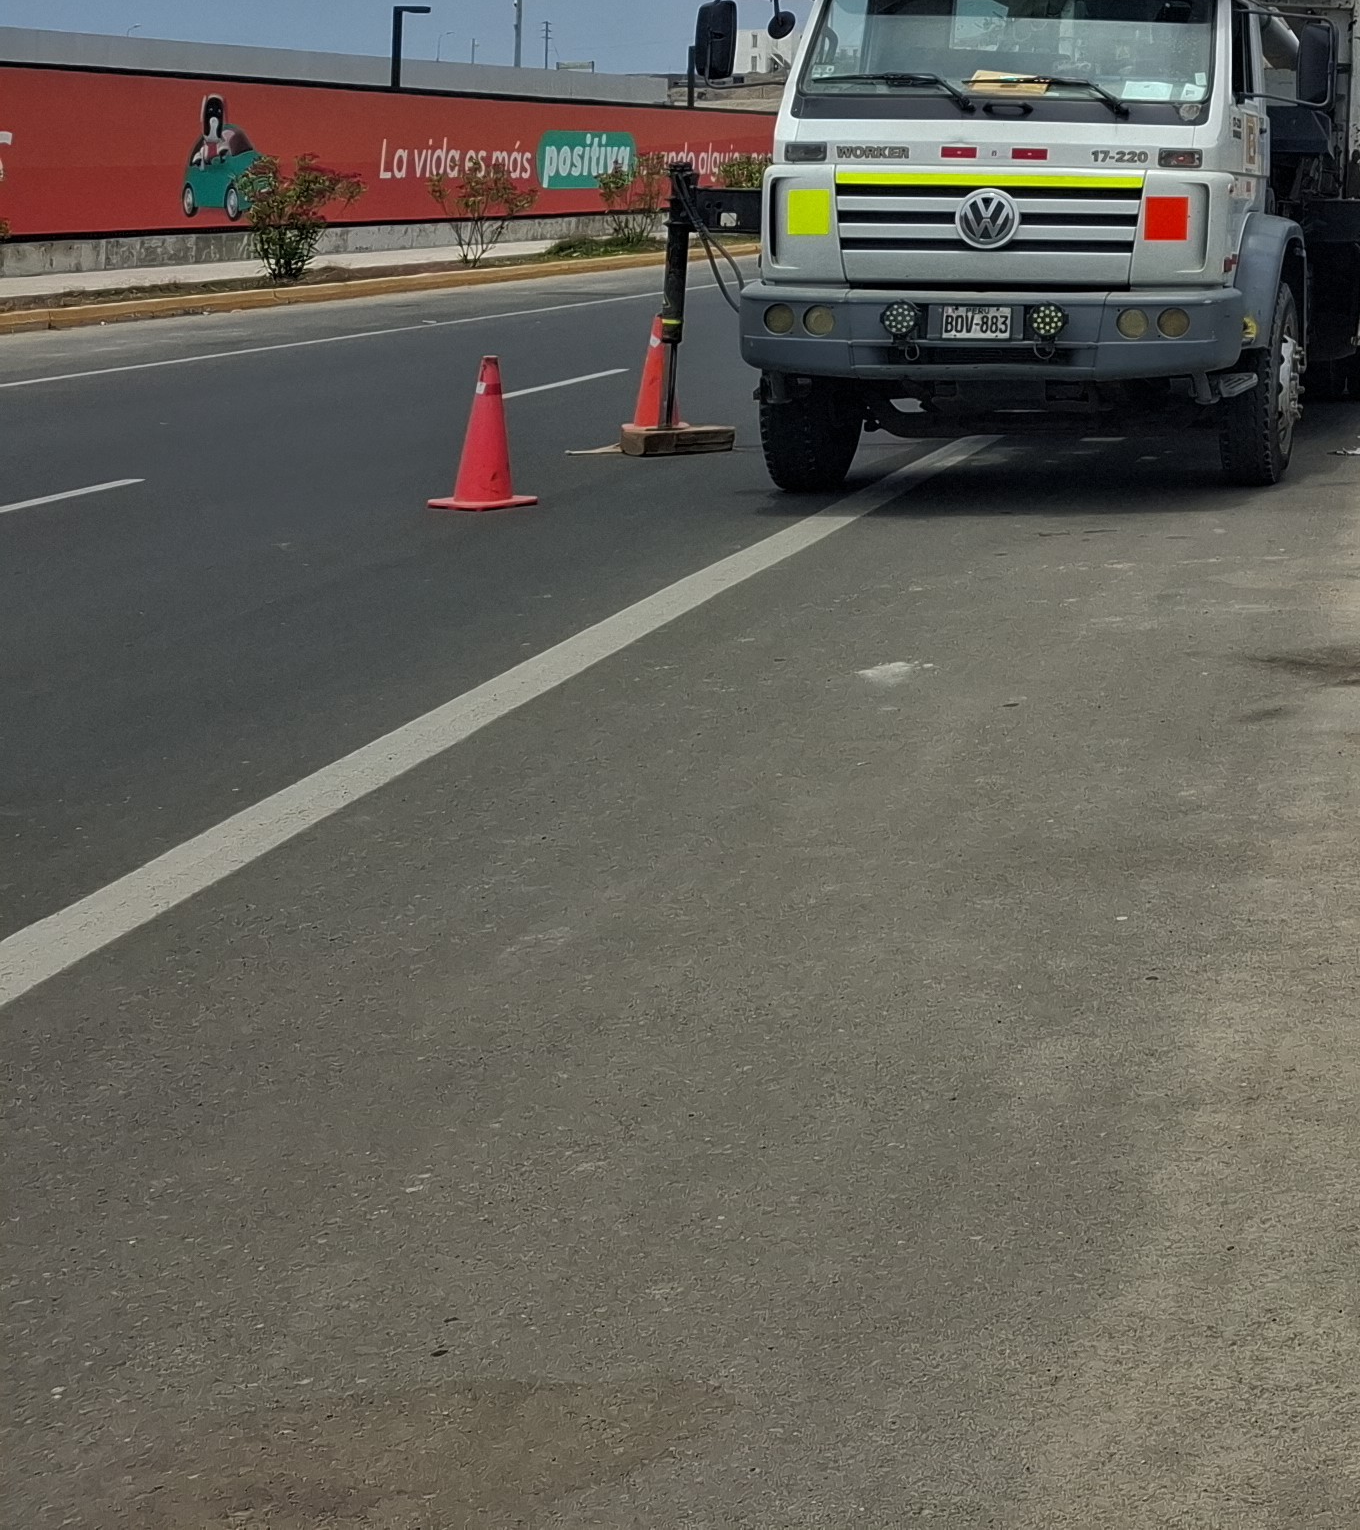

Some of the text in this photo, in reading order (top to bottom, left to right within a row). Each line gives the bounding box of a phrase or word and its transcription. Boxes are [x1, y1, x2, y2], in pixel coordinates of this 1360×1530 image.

[379, 138, 408, 179] La
[414, 137, 461, 178] vida
[465, 149, 486, 178] es
[490, 140, 532, 179] más
[542, 133, 631, 188] positiva
[836, 145, 910, 160] WORKER
[1091, 149, 1149, 164] 17-220
[944, 314, 1010, 334] BOV-883
